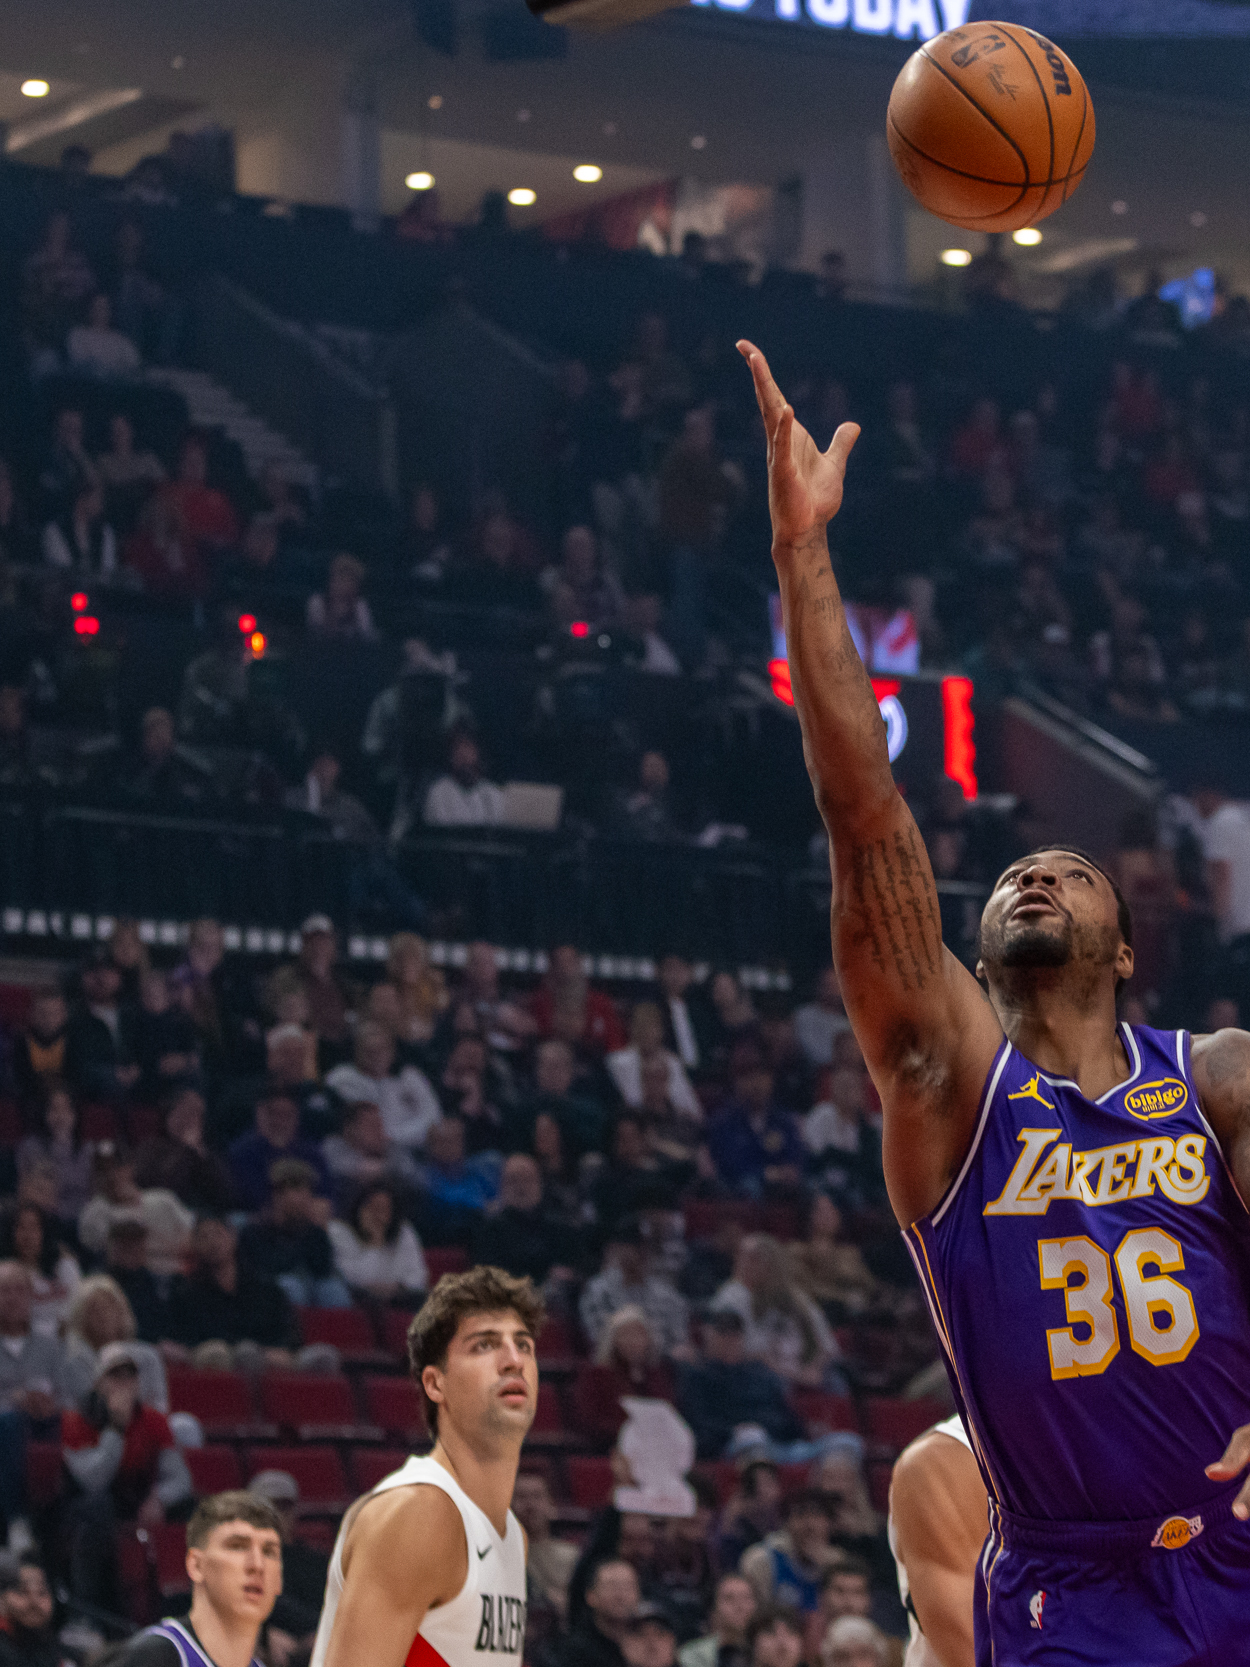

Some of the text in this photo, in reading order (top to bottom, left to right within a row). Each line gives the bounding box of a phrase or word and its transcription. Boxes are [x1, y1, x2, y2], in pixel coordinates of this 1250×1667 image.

[1129, 1086, 1184, 1109] bibigo
[982, 1128, 1211, 1216] LAKERS
[1037, 1226, 1201, 1381] 36
